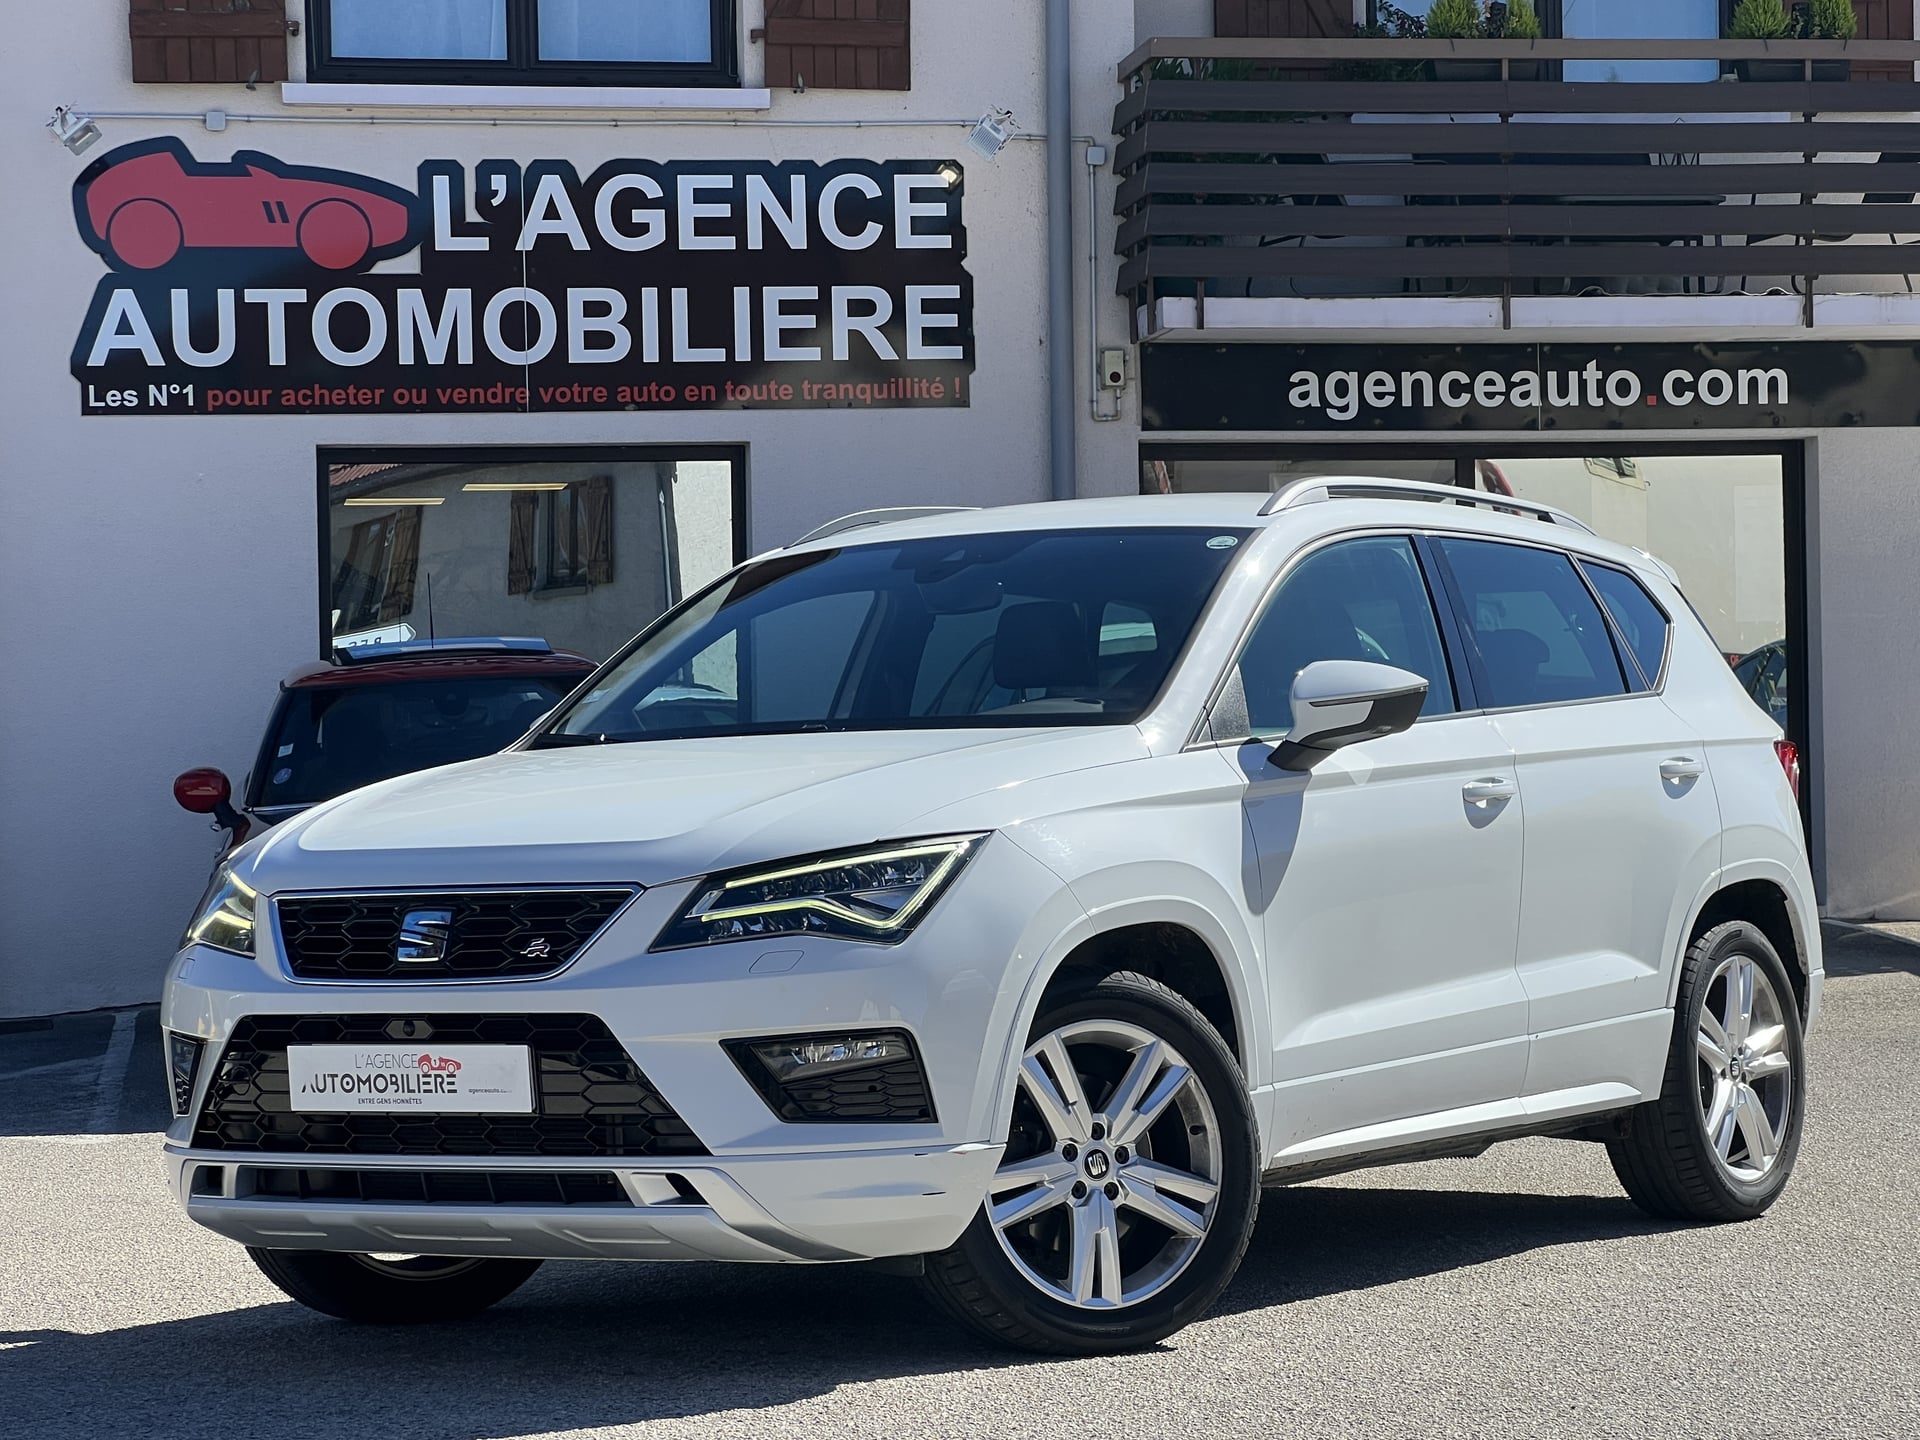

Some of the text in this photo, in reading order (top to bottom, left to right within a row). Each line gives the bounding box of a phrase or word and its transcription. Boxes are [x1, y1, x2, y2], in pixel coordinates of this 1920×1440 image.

[86, 285, 964, 367] AUTOMOBILIERE
[88, 384, 139, 407] Les
[148, 384, 195, 407] N°1
[207, 388, 273, 411] pour
[280, 383, 385, 406] acheter
[392, 387, 427, 404] ou
[436, 382, 530, 405] vendre
[538, 382, 608, 403] votre
[616, 381, 676, 403] auto
[684, 384, 716, 402] en
[725, 380, 794, 401] toute
[801, 376, 945, 405] tranquillité
[1287, 358, 1790, 421] agenceauto.com
